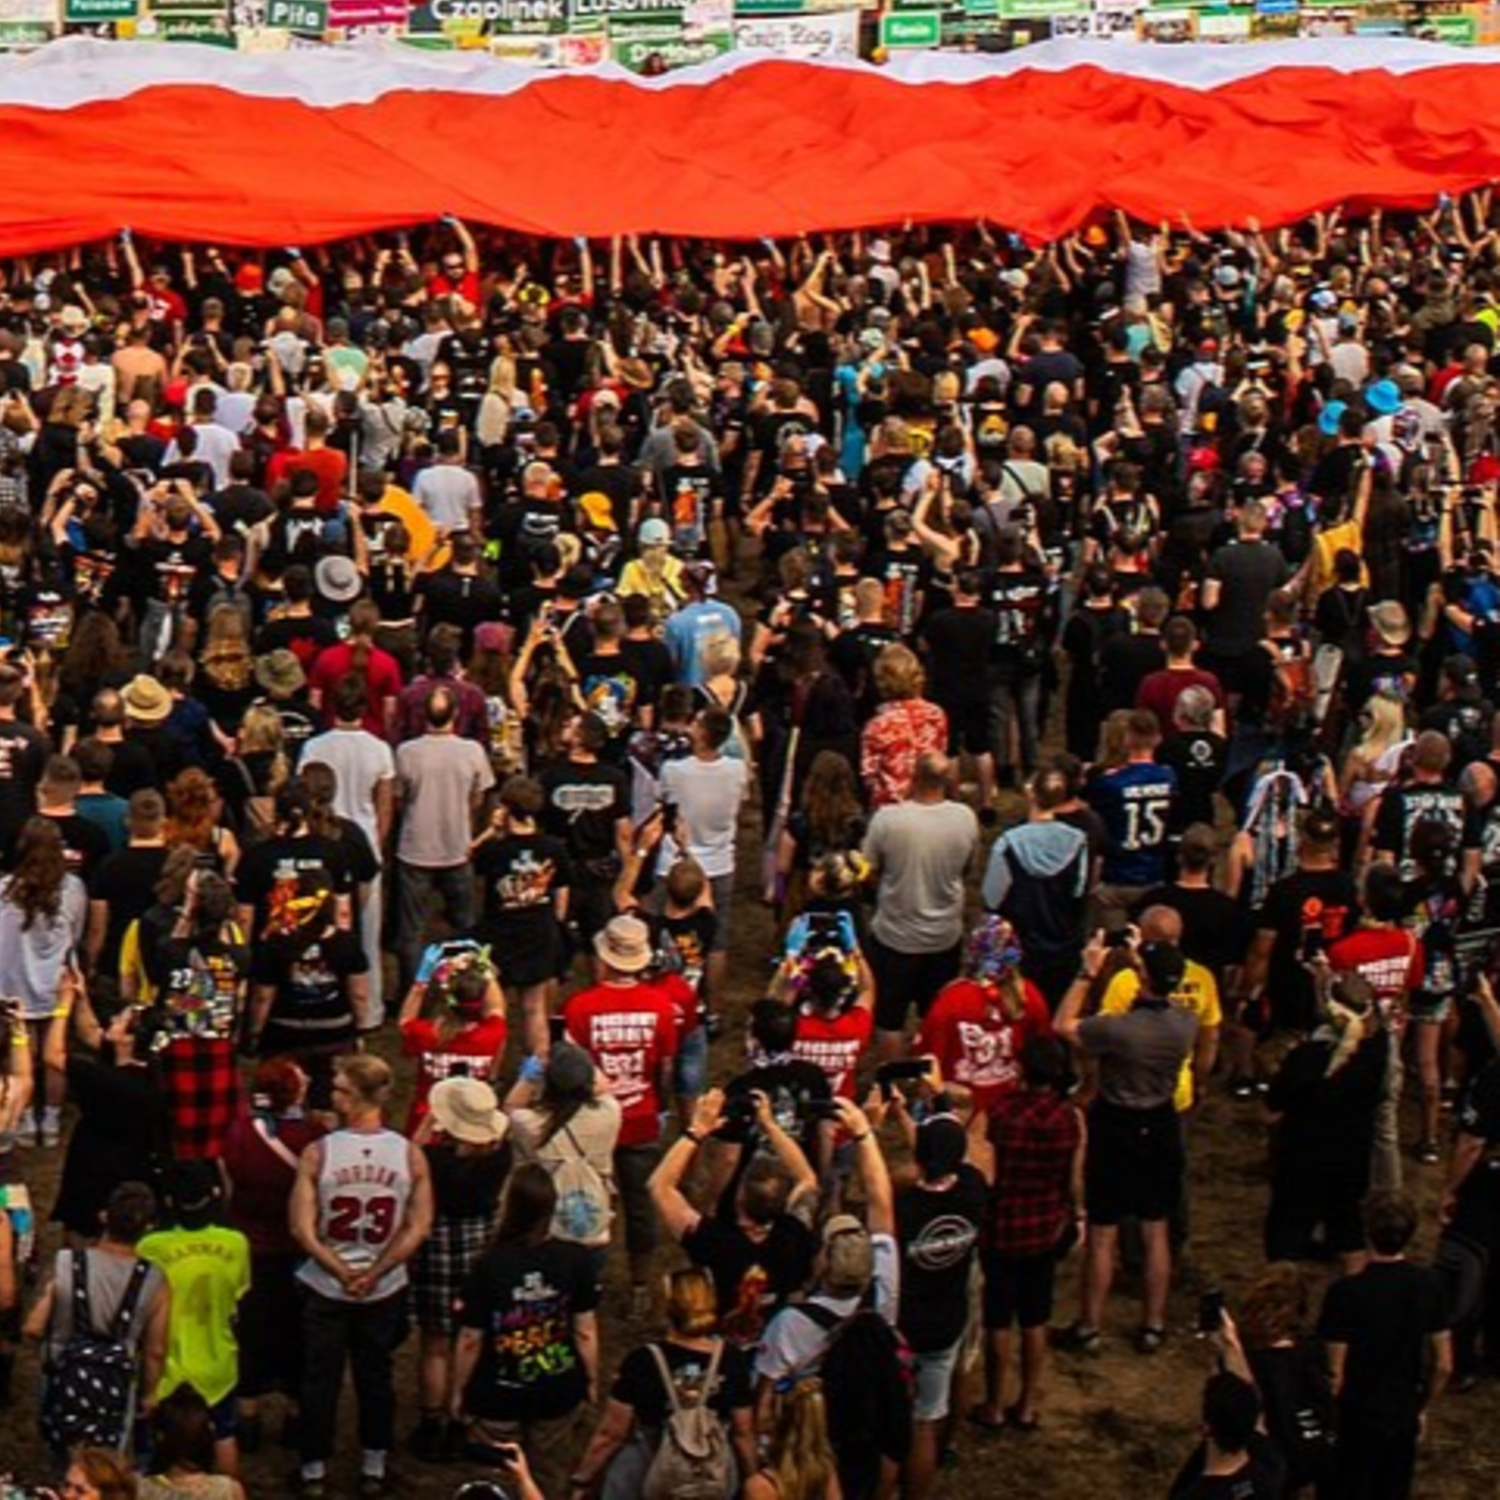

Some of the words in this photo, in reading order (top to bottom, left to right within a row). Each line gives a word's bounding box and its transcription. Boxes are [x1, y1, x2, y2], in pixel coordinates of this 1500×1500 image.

[271, 0, 320, 28] Piła
[1121, 800, 1171, 851] 15
[331, 1164, 399, 1188] JORDAN
[328, 1195, 397, 1245] 23
